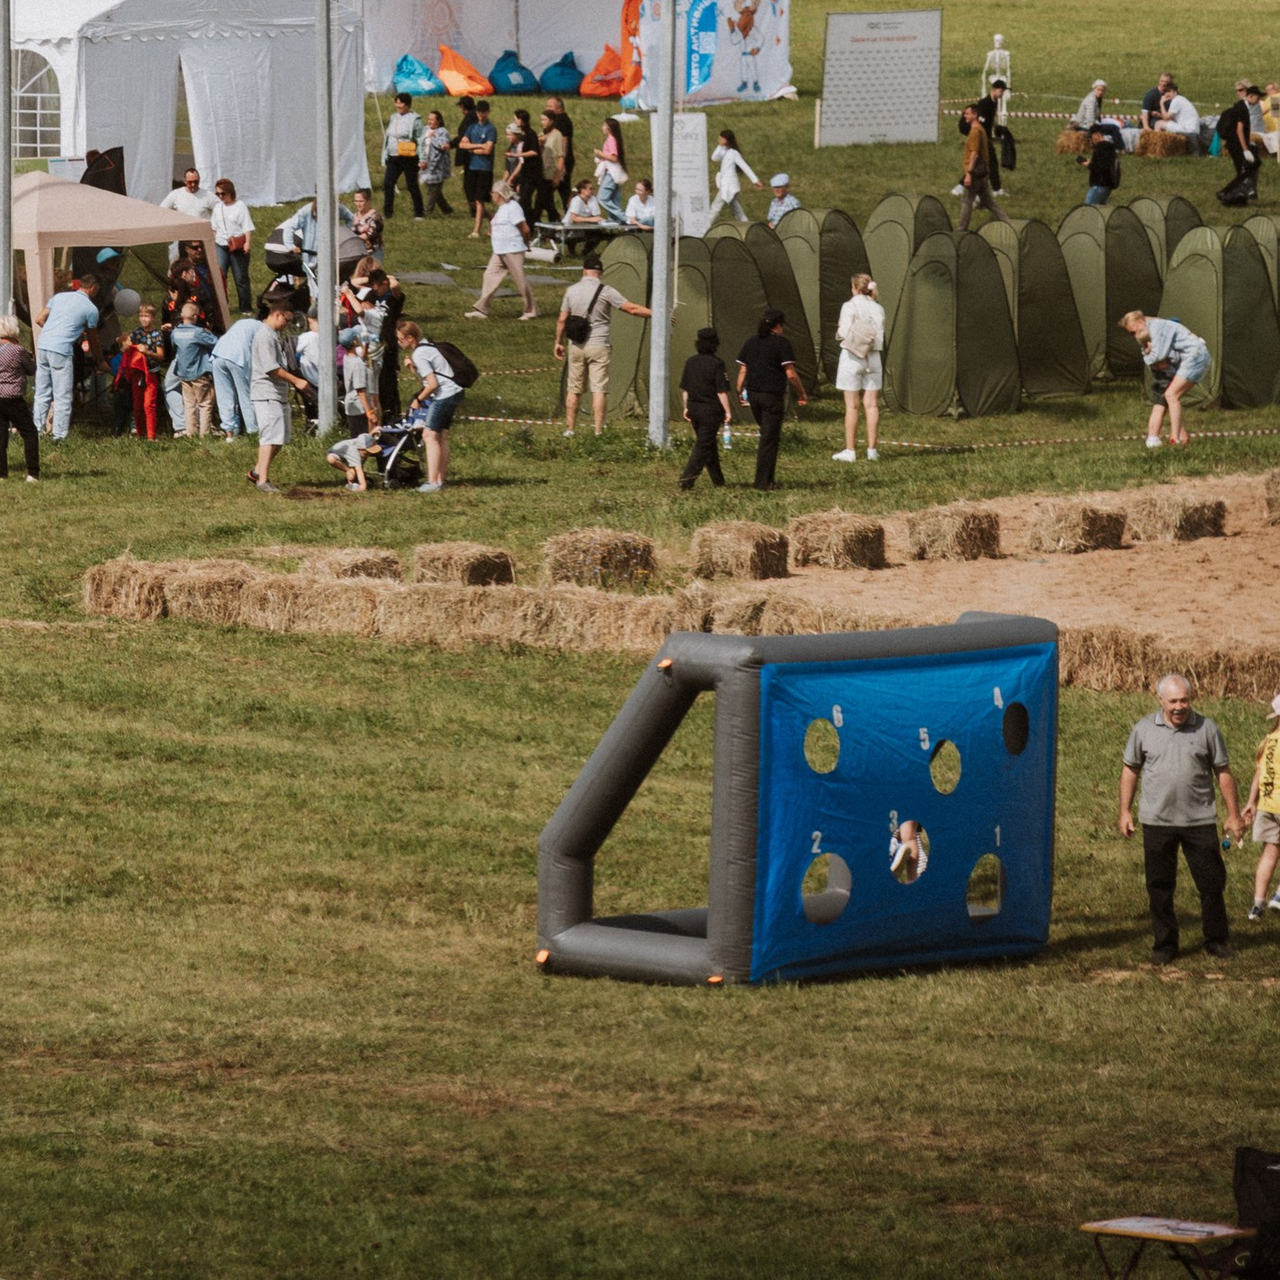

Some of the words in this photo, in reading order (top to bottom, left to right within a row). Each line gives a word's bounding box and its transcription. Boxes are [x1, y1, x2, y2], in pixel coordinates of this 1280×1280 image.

[993, 686, 1004, 709] 4
[832, 704, 843, 728] 6
[919, 727, 930, 750] 5
[889, 810, 898, 832] 3
[811, 831, 822, 853] 2
[994, 825, 1001, 847] 1
